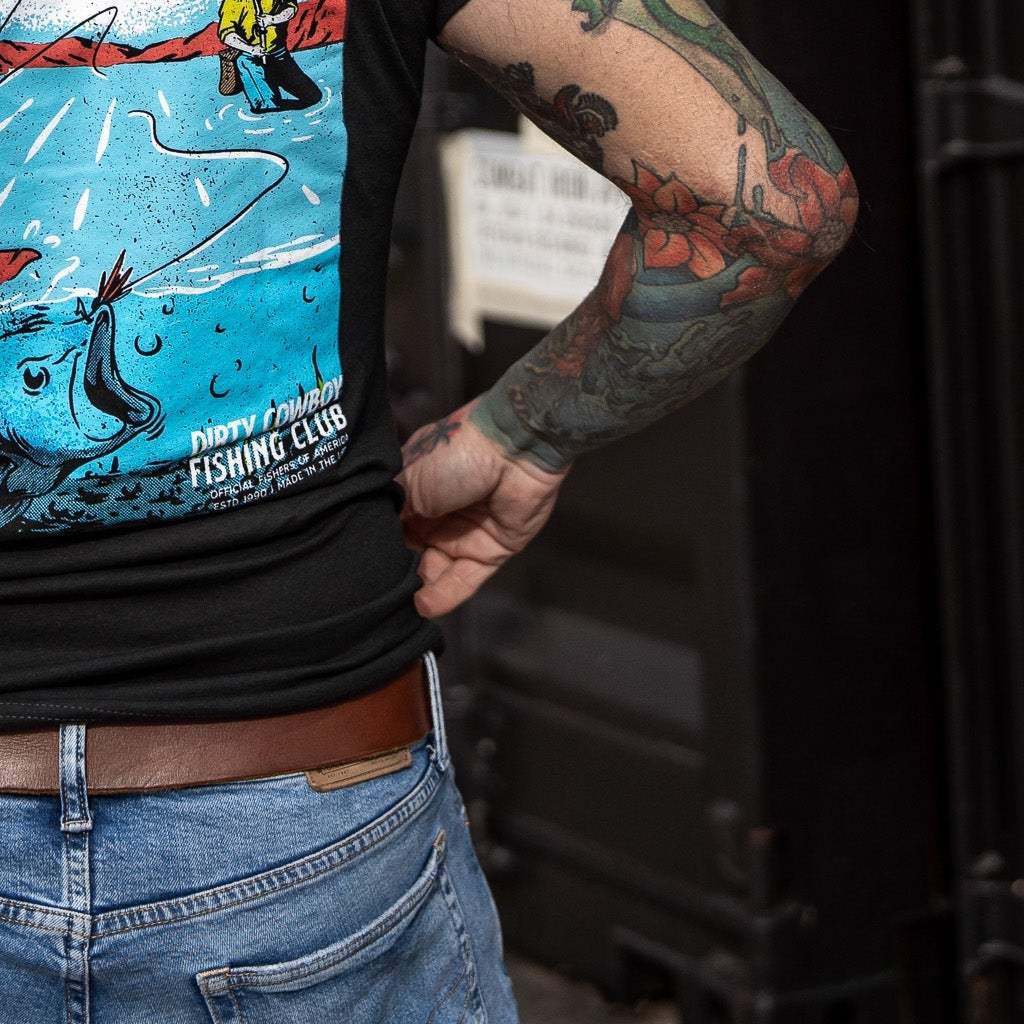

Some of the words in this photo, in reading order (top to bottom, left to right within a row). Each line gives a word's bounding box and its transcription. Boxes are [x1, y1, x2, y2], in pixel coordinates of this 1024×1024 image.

[188, 430, 286, 488] FISHING
[290, 403, 348, 450] CLUB
[190, 414, 257, 456] DIRTY
[262, 374, 344, 432] COWBOY
[210, 479, 255, 500] OFFICIAL
[257, 461, 297, 485] FISHERS
[297, 452, 311, 466] OF
[213, 497, 240, 511] ESTD
[318, 454, 337, 471] THE
